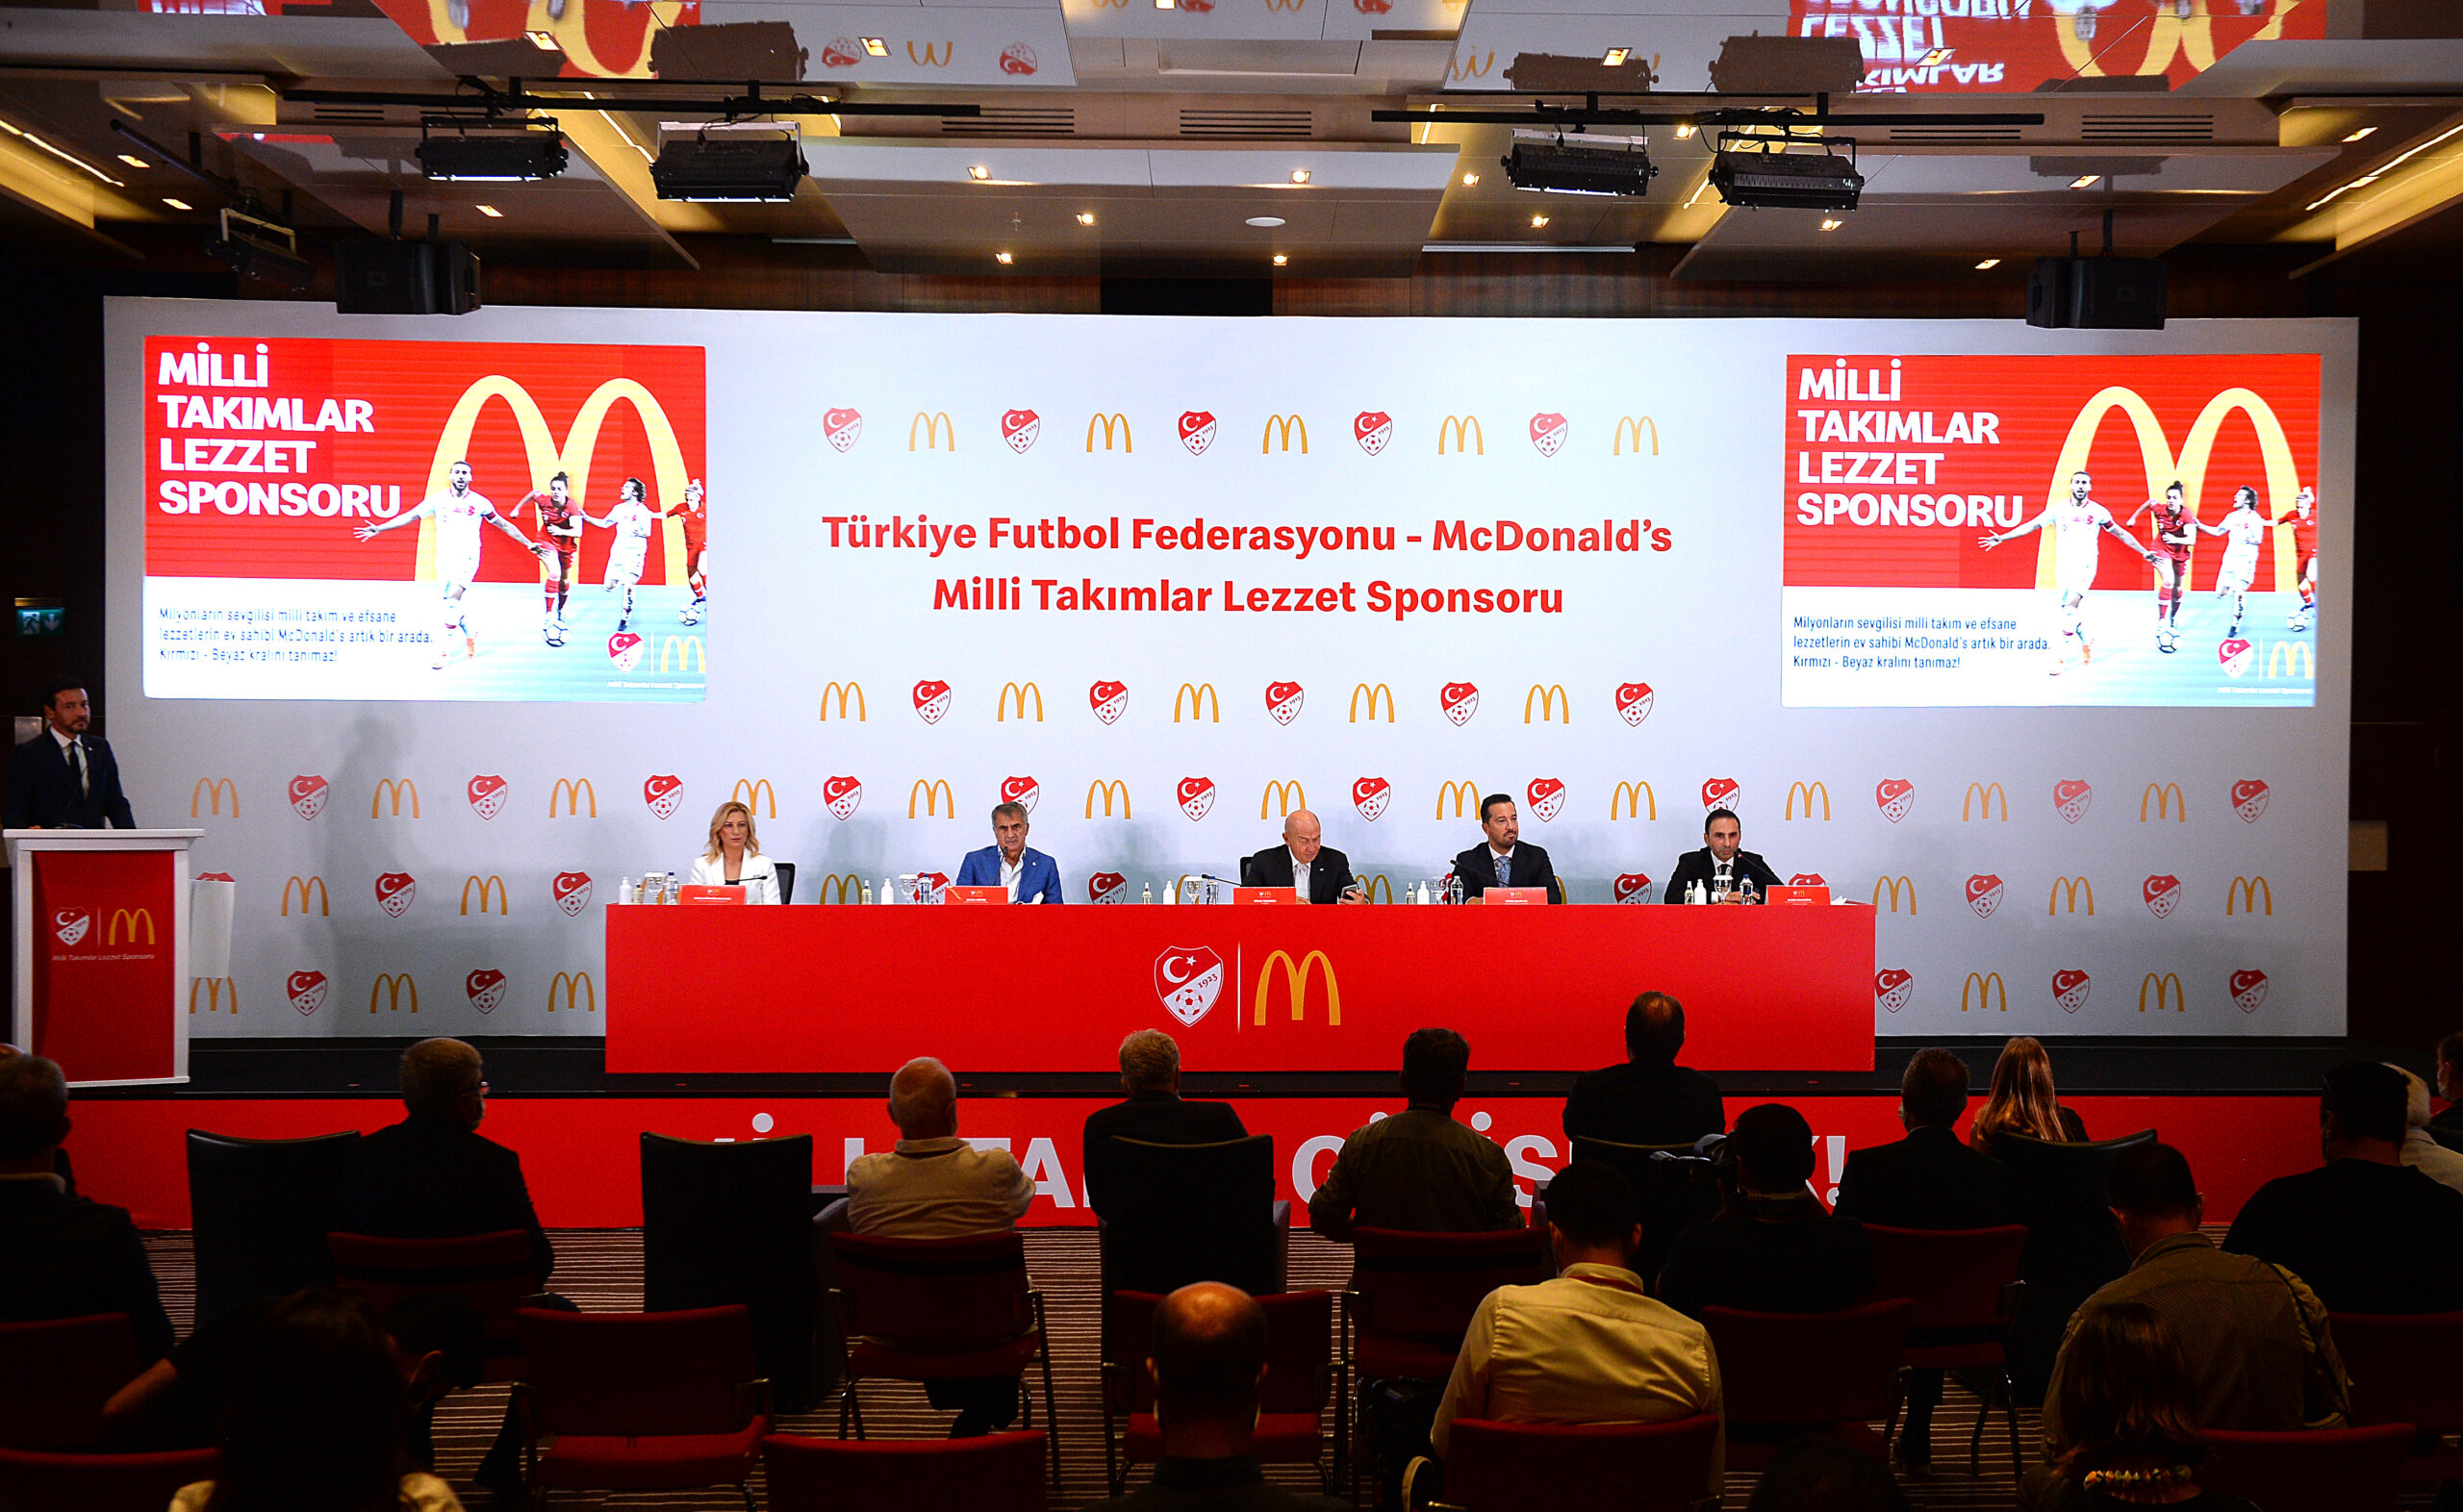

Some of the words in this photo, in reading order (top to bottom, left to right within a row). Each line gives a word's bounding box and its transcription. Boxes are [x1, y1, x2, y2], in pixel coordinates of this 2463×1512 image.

[159, 342, 267, 388] MİLLİ
[1798, 358, 1902, 401] MİLLİ
[158, 394, 374, 433] TAKIMLAR
[1797, 410, 2000, 444] TAKIMLAR
[160, 438, 317, 474] LEZZET
[1797, 452, 1944, 485] LEZZET
[160, 480, 401, 518] SPONSORU
[1797, 492, 2023, 528] SPONSORU
[823, 515, 977, 559] Türkiye
[989, 516, 1118, 549] Futbol
[1132, 517, 1395, 561] Federasyonu
[1434, 519, 1672, 552] McDonald’s
[934, 576, 1020, 611] Milli
[1031, 578, 1212, 612] Takımlar
[1225, 580, 1357, 613] Lezzet
[1367, 580, 1562, 621] Sponsoru
[227, 608, 274, 624] sevgilisi
[278, 608, 302, 621] milli
[305, 609, 338, 622] takım
[342, 612, 355, 622] ve
[358, 610, 396, 623] efsane
[1793, 617, 1854, 632] Milyonların
[1857, 617, 1902, 633] sevgilisi
[1905, 617, 1928, 629] milli
[1931, 617, 1962, 630] takım
[1965, 620, 1977, 630] ve
[1980, 617, 2017, 631] efsane
[224, 631, 236, 642] ev
[241, 629, 274, 642] sahibi
[278, 629, 344, 643] McDonald's
[349, 630, 375, 643] artık
[379, 630, 394, 643] bir
[397, 631, 433, 643] arada.
[1793, 636, 1850, 648] lezzetlerin
[1853, 639, 1866, 649] ev
[1869, 636, 1902, 649] sahibi
[1905, 637, 1968, 649] McDonald's
[1971, 637, 1996, 650] artık
[1999, 637, 2015, 650] bir
[2018, 637, 2051, 650] arada.
[160, 647, 200, 661] Kırmızı
[212, 648, 245, 664] Beyaz
[249, 648, 285, 662] kralını
[289, 649, 338, 663] tanımaz!
[1793, 656, 1831, 668] Kırmızı
[1842, 656, 1874, 671] Beyaz
[1877, 656, 1911, 668] kralını
[1915, 656, 1961, 668] tanımaz!
[1198, 972, 1219, 989] 1923
